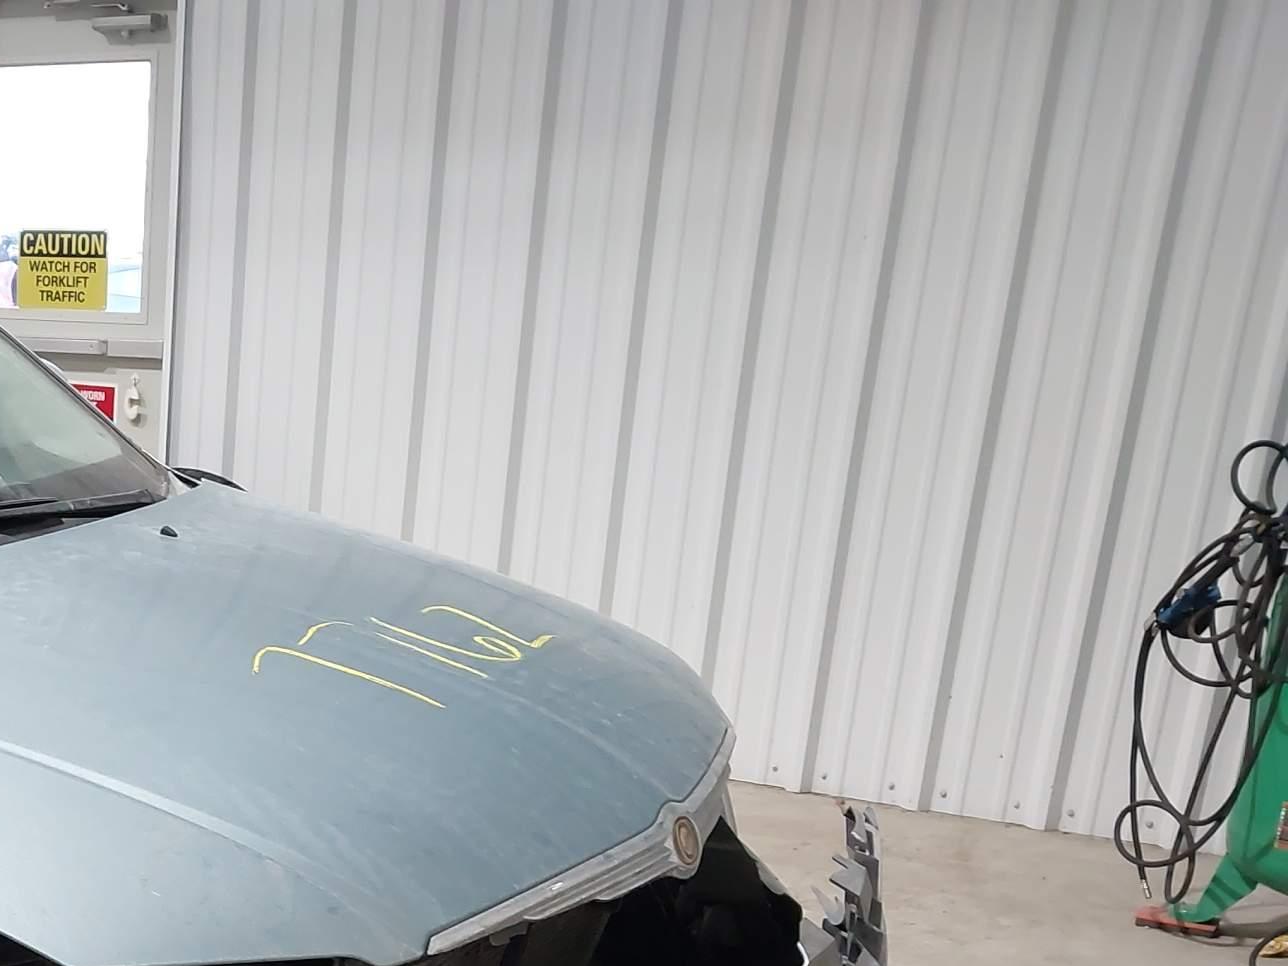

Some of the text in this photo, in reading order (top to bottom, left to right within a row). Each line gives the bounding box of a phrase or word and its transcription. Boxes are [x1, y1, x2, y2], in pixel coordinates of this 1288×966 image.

[22, 232, 105, 256] CAUTION
[29, 260, 97, 273] WATCH FOR
[36, 275, 90, 288] FORKLIFT
[39, 289, 86, 303] TRAFFIC
